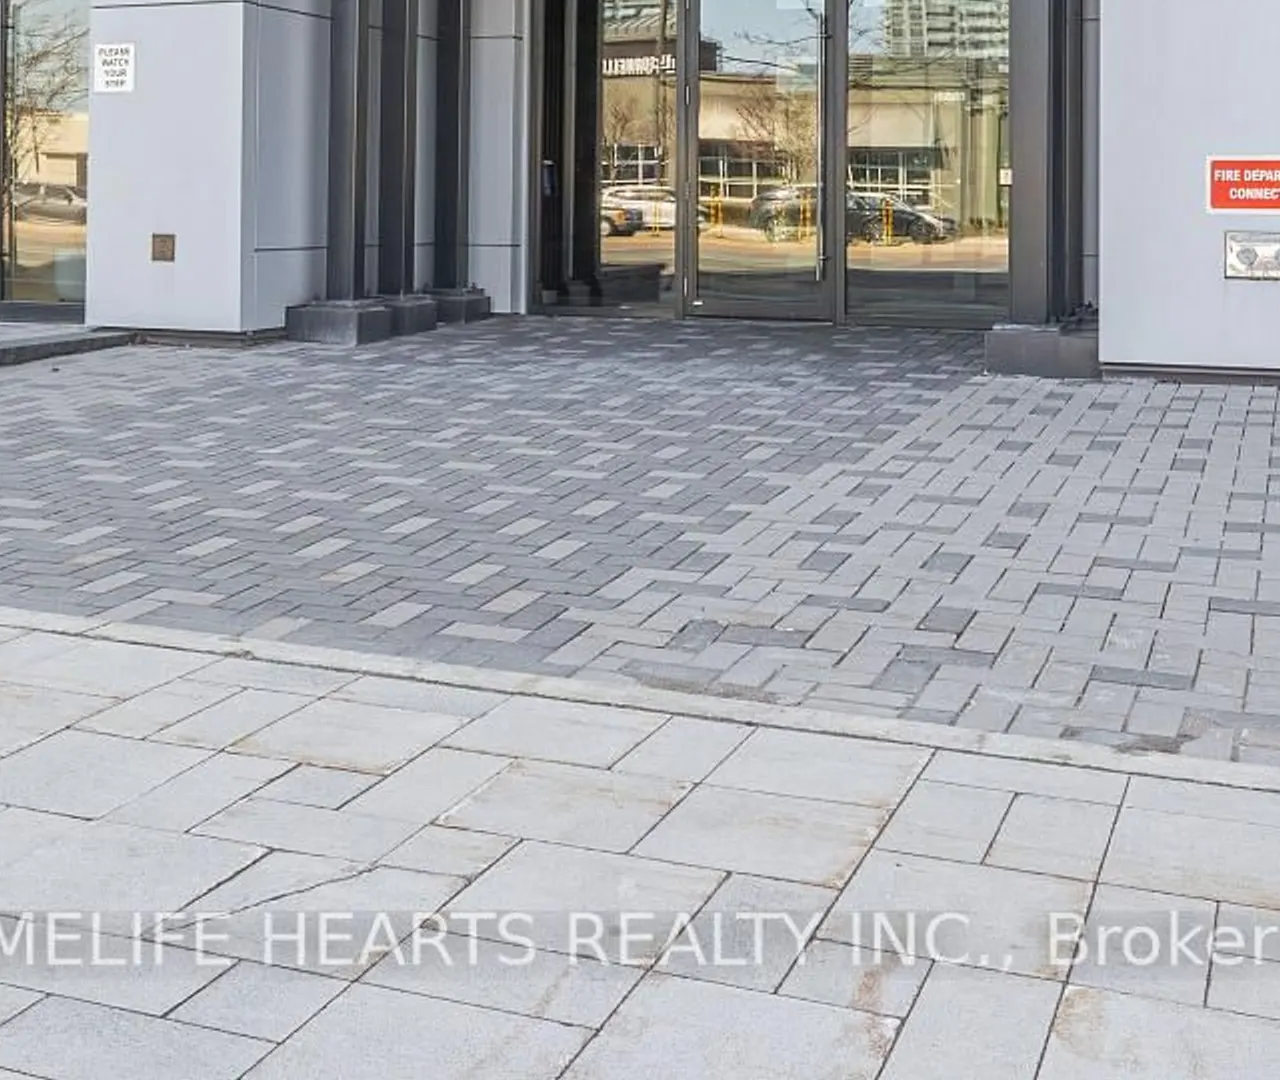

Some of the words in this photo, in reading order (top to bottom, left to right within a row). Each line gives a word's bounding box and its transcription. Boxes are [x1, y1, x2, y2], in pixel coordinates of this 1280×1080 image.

[101, 58, 130, 68] WATCH
[104, 68, 127, 77] YOUR
[1214, 169, 1241, 182] FIRE
